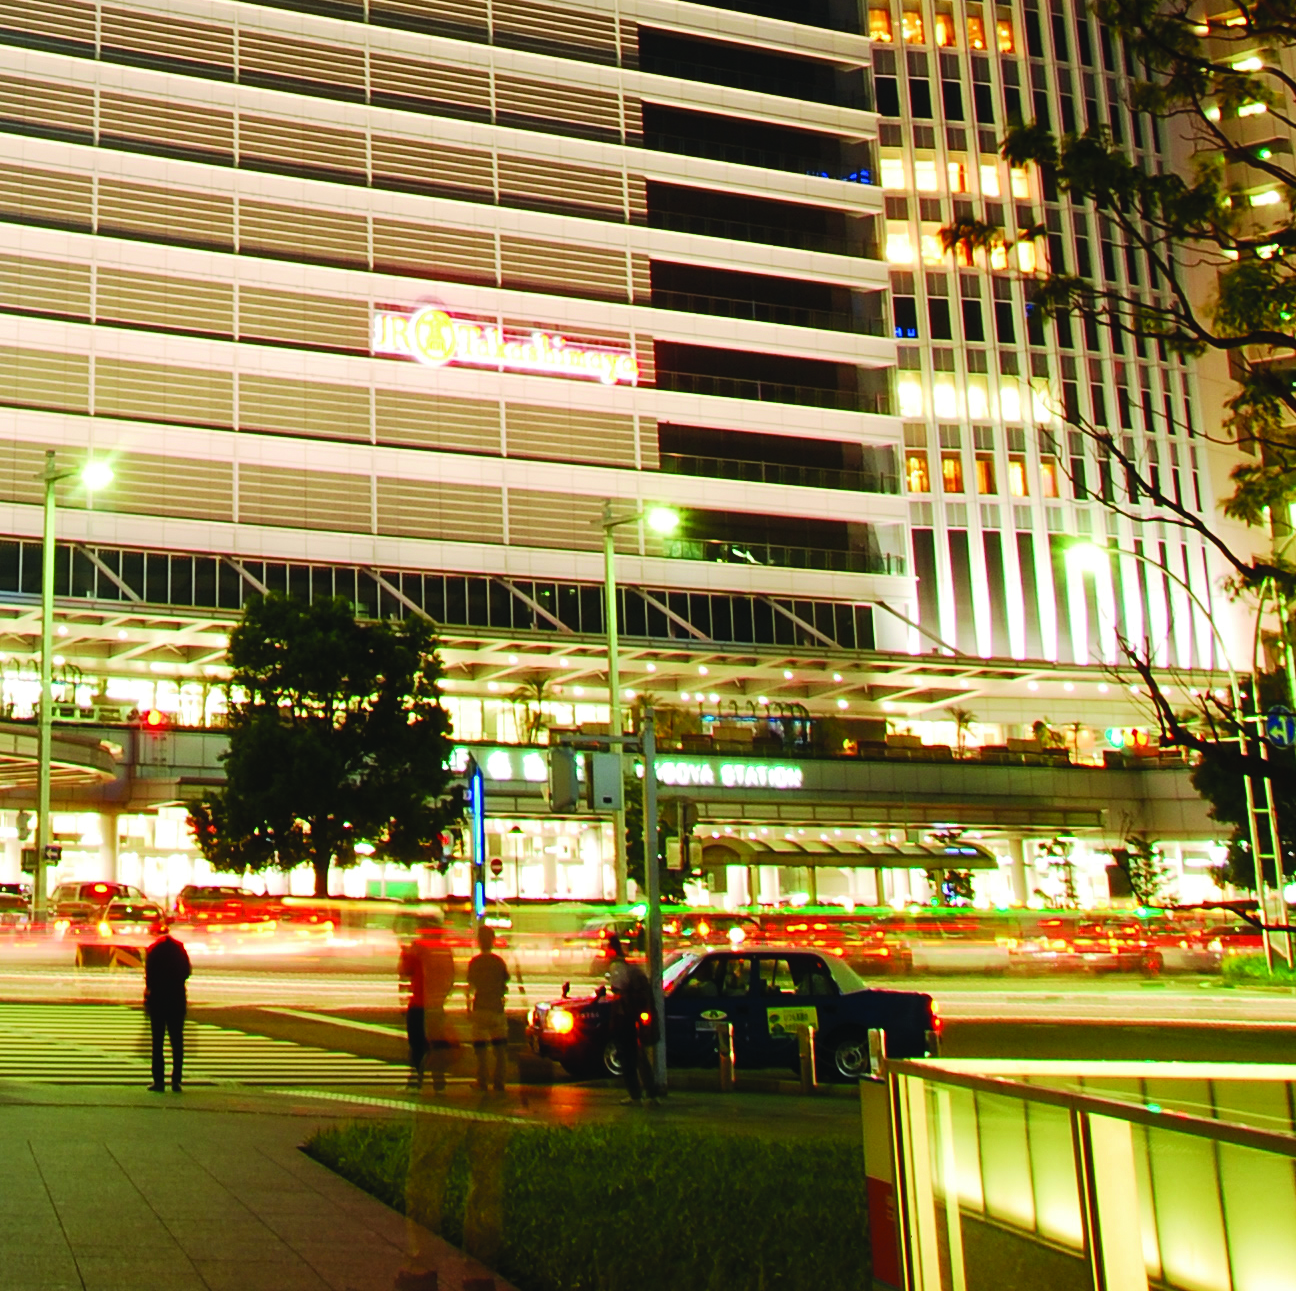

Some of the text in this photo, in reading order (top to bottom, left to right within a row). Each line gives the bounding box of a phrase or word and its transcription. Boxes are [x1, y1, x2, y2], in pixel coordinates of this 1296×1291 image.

[375, 313, 639, 383] JR Takashimaya
[720, 763, 803, 789] STATION
